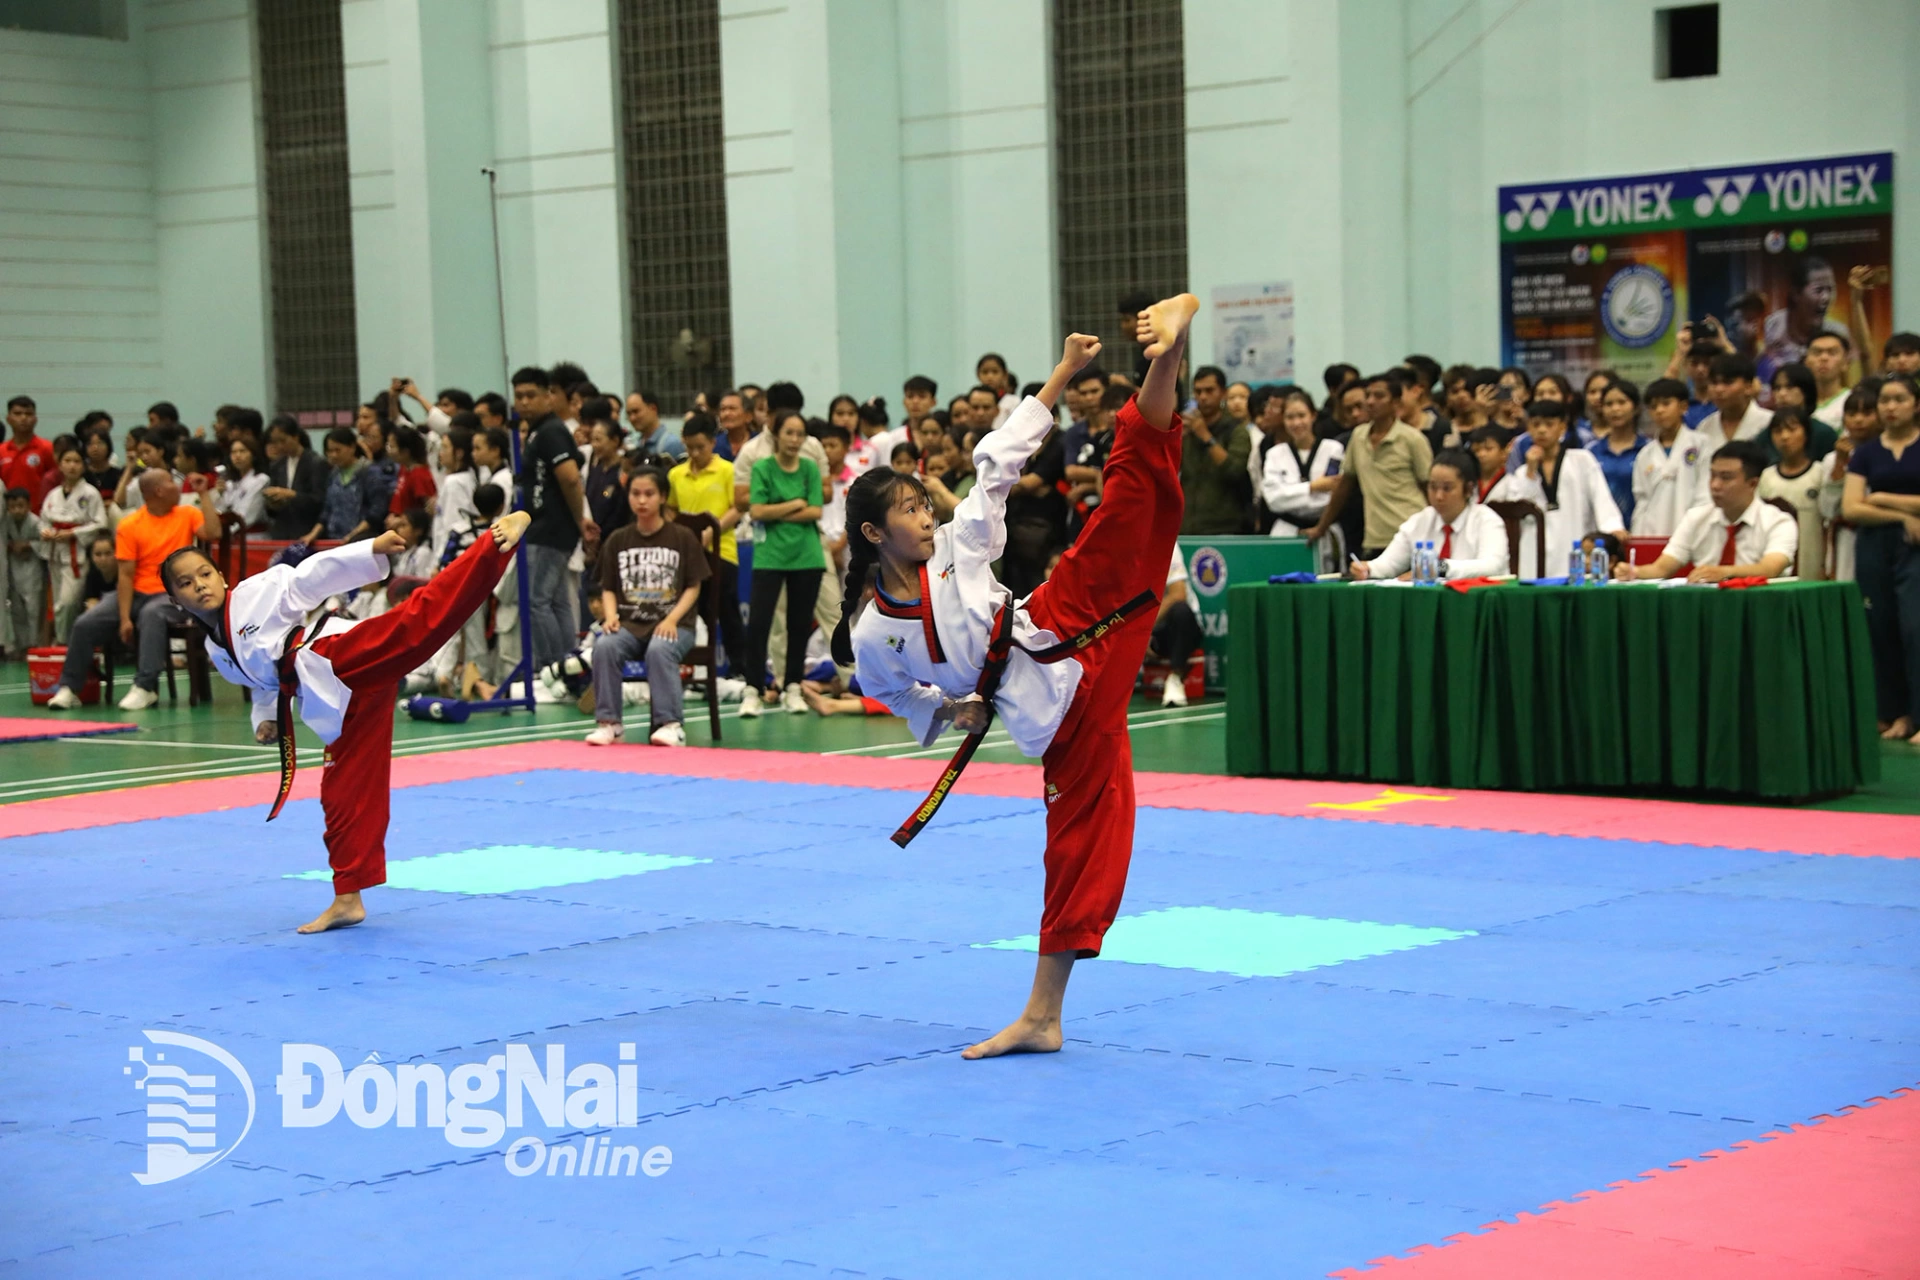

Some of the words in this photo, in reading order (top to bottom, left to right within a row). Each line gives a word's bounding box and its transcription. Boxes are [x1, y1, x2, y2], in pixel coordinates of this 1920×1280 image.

[1567, 182, 1675, 228] YONEX
[1762, 163, 1879, 212] YONEX
[917, 769, 958, 822] TAEKWONDO
